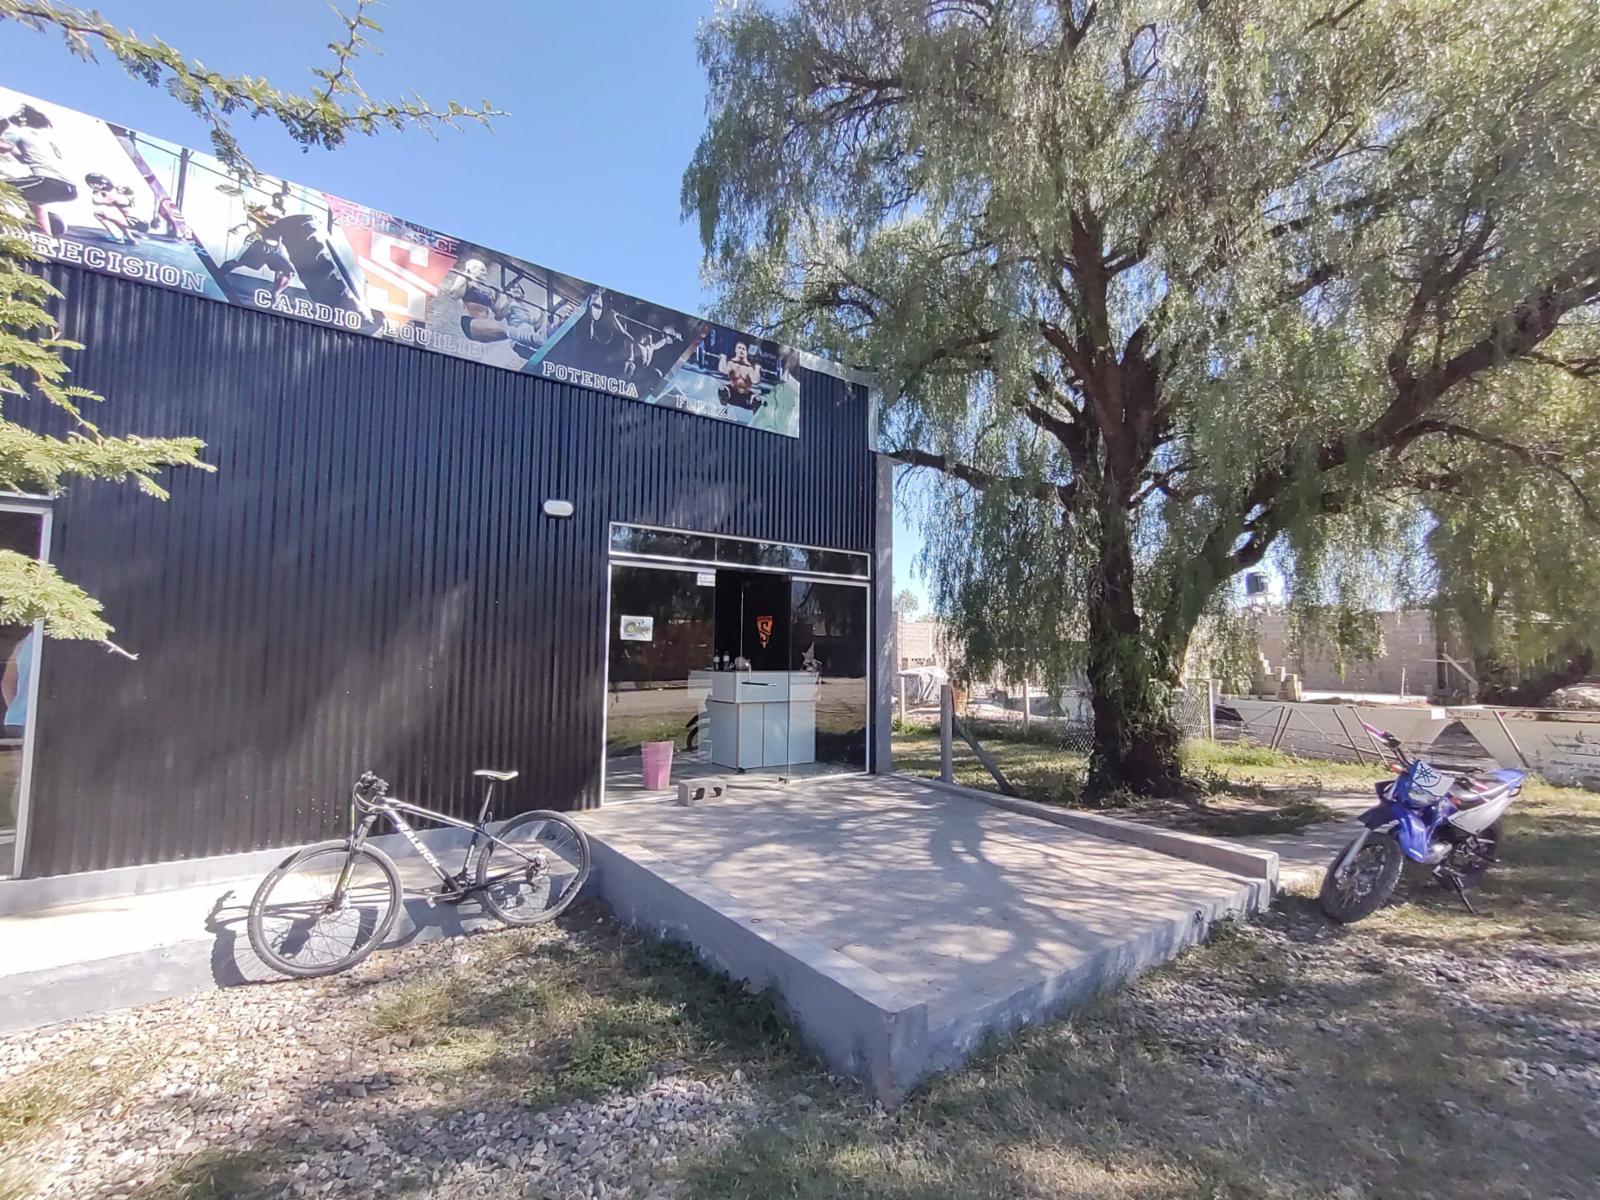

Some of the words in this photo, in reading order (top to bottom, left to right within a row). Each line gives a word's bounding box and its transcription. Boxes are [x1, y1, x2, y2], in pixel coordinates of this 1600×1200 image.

[254, 288, 362, 330] CARDIO
[542, 360, 639, 398] POTENCIA
[397, 822, 440, 867] RALEIGH
